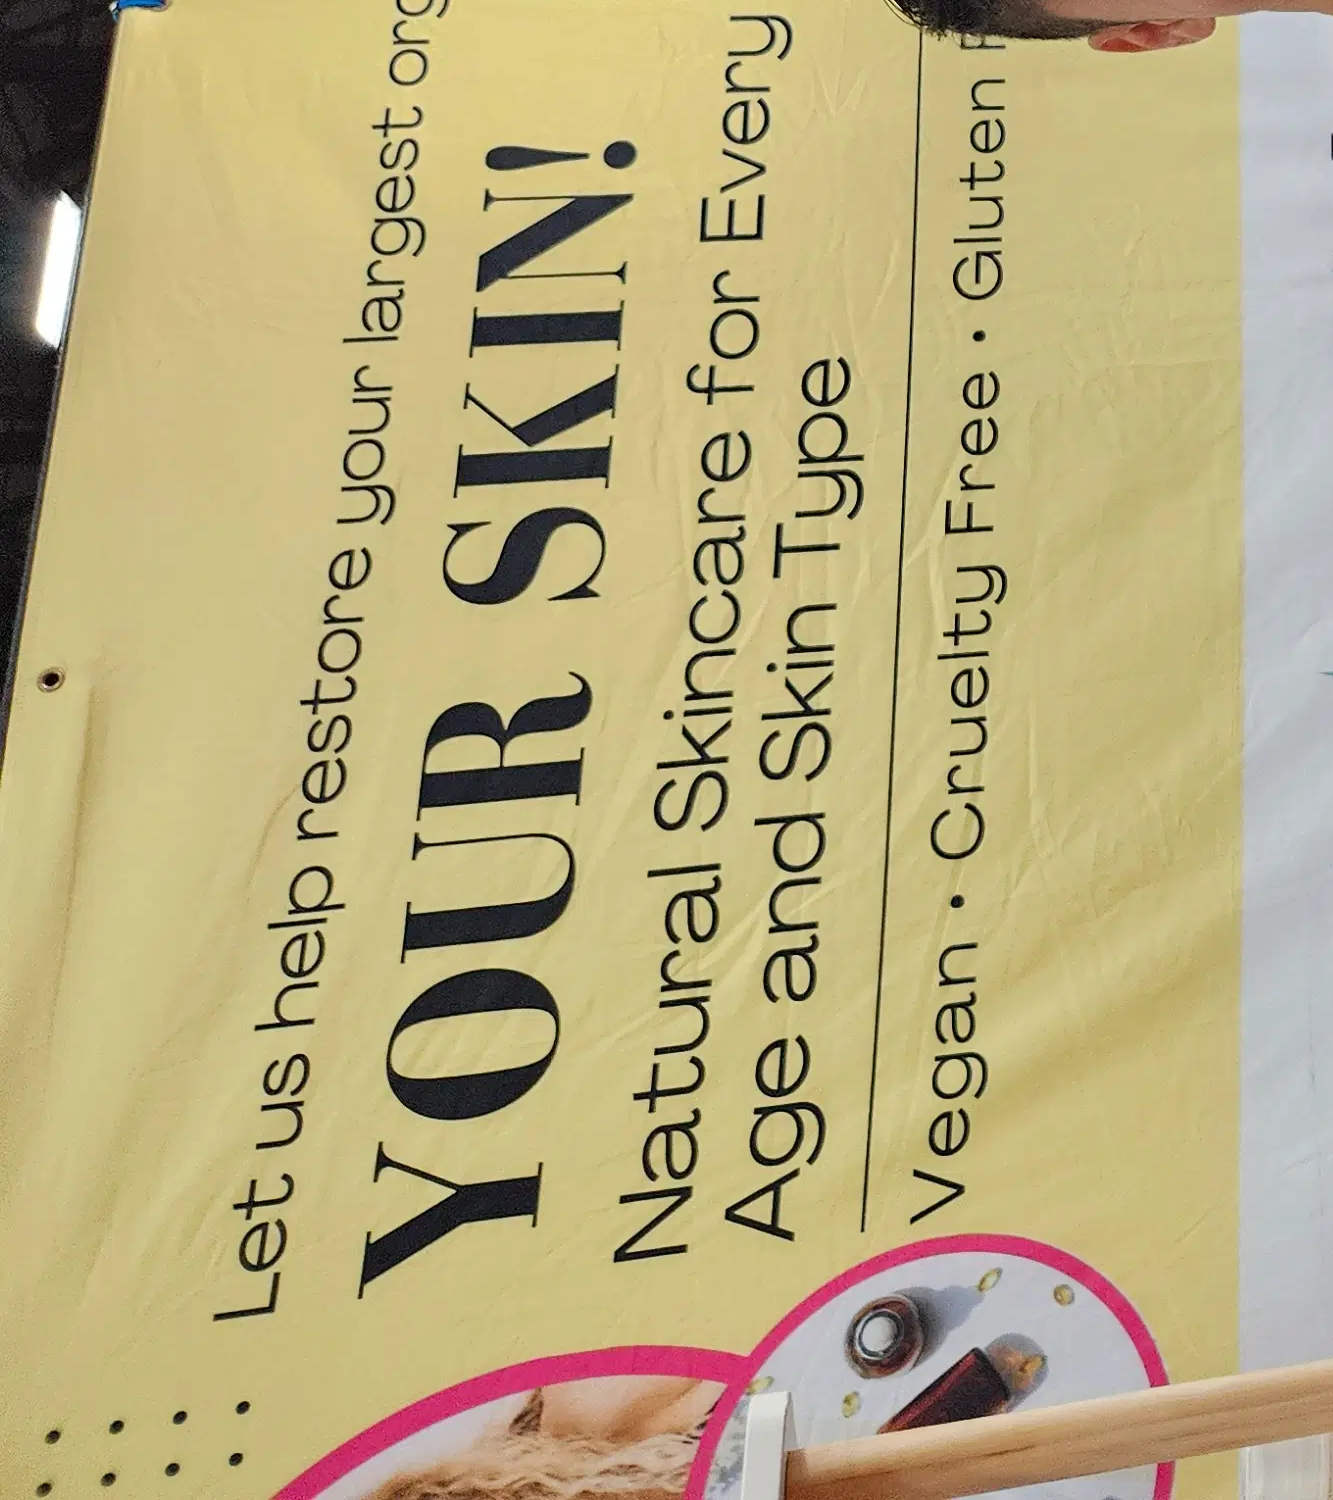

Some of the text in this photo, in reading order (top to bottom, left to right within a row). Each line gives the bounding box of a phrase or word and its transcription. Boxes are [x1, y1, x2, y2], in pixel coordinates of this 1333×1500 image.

[343, 106, 426, 343] largest
[952, 78, 1006, 300] Gluten
[334, 365, 393, 525] your
[945, 371, 999, 535] Free
[295, 548, 372, 840] restore
[357, 139, 637, 1300] YOUR SKIN!
[613, 14, 792, 1263] Natural Skincare for Every
[930, 564, 1007, 860] Cruelty
[724, 356, 865, 1242] Age and Skin Type
[256, 865, 345, 1030] help
[256, 1053, 311, 1149] us
[910, 942, 988, 1225] Vegan
[213, 1174, 295, 1322] Let
